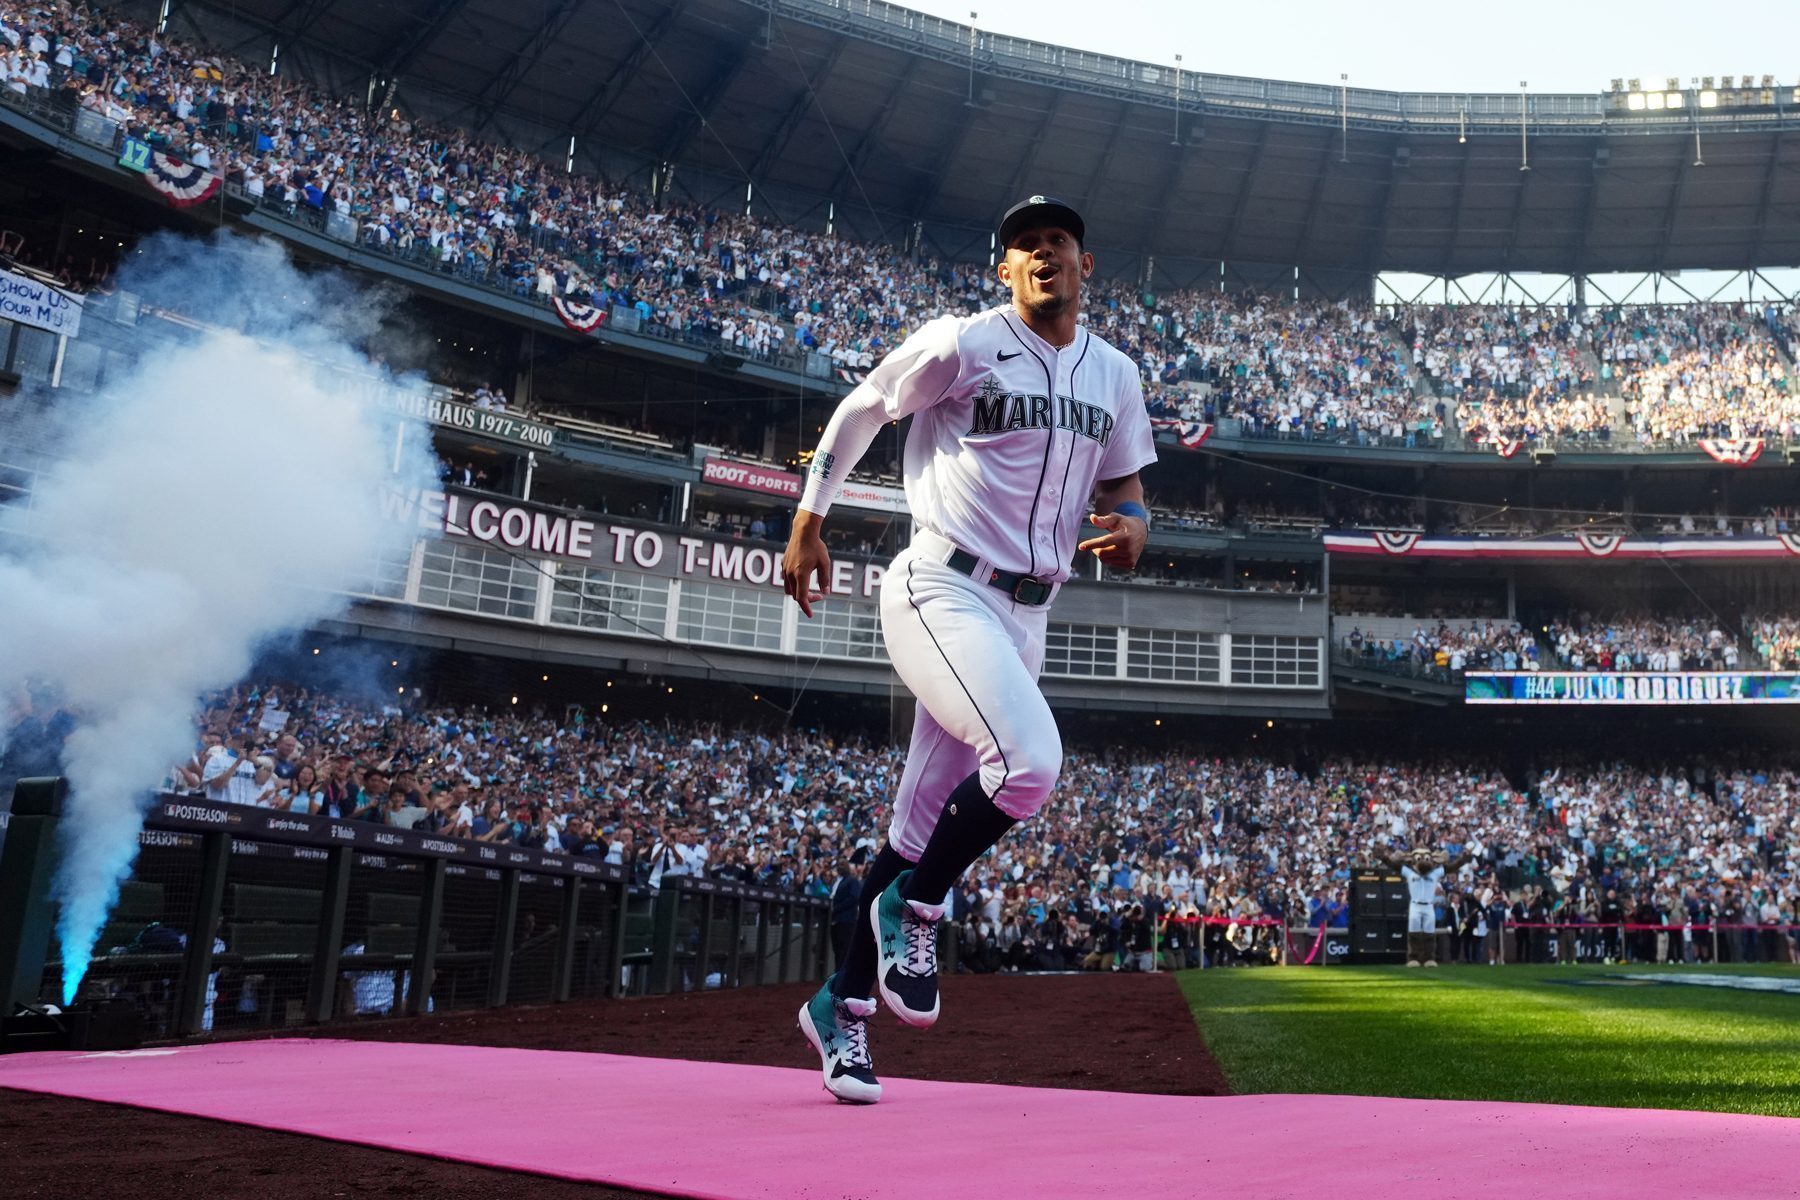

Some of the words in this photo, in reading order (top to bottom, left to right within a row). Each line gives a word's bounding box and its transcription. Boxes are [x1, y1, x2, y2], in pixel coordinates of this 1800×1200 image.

[123, 140, 149, 167] 17
[0, 277, 43, 301] SHOW
[48, 290, 69, 310] US
[480, 414, 553, 447] 1977-2010
[705, 463, 748, 483] ROOT
[748, 474, 799, 493] SPORTS
[380, 486, 594, 559] WELCOME
[609, 526, 664, 568] TO
[680, 537, 854, 595] T-MOLE
[1525, 676, 1556, 699] #44
[1562, 676, 1618, 700] JULIO
[175, 804, 228, 823] POSTSEASON
